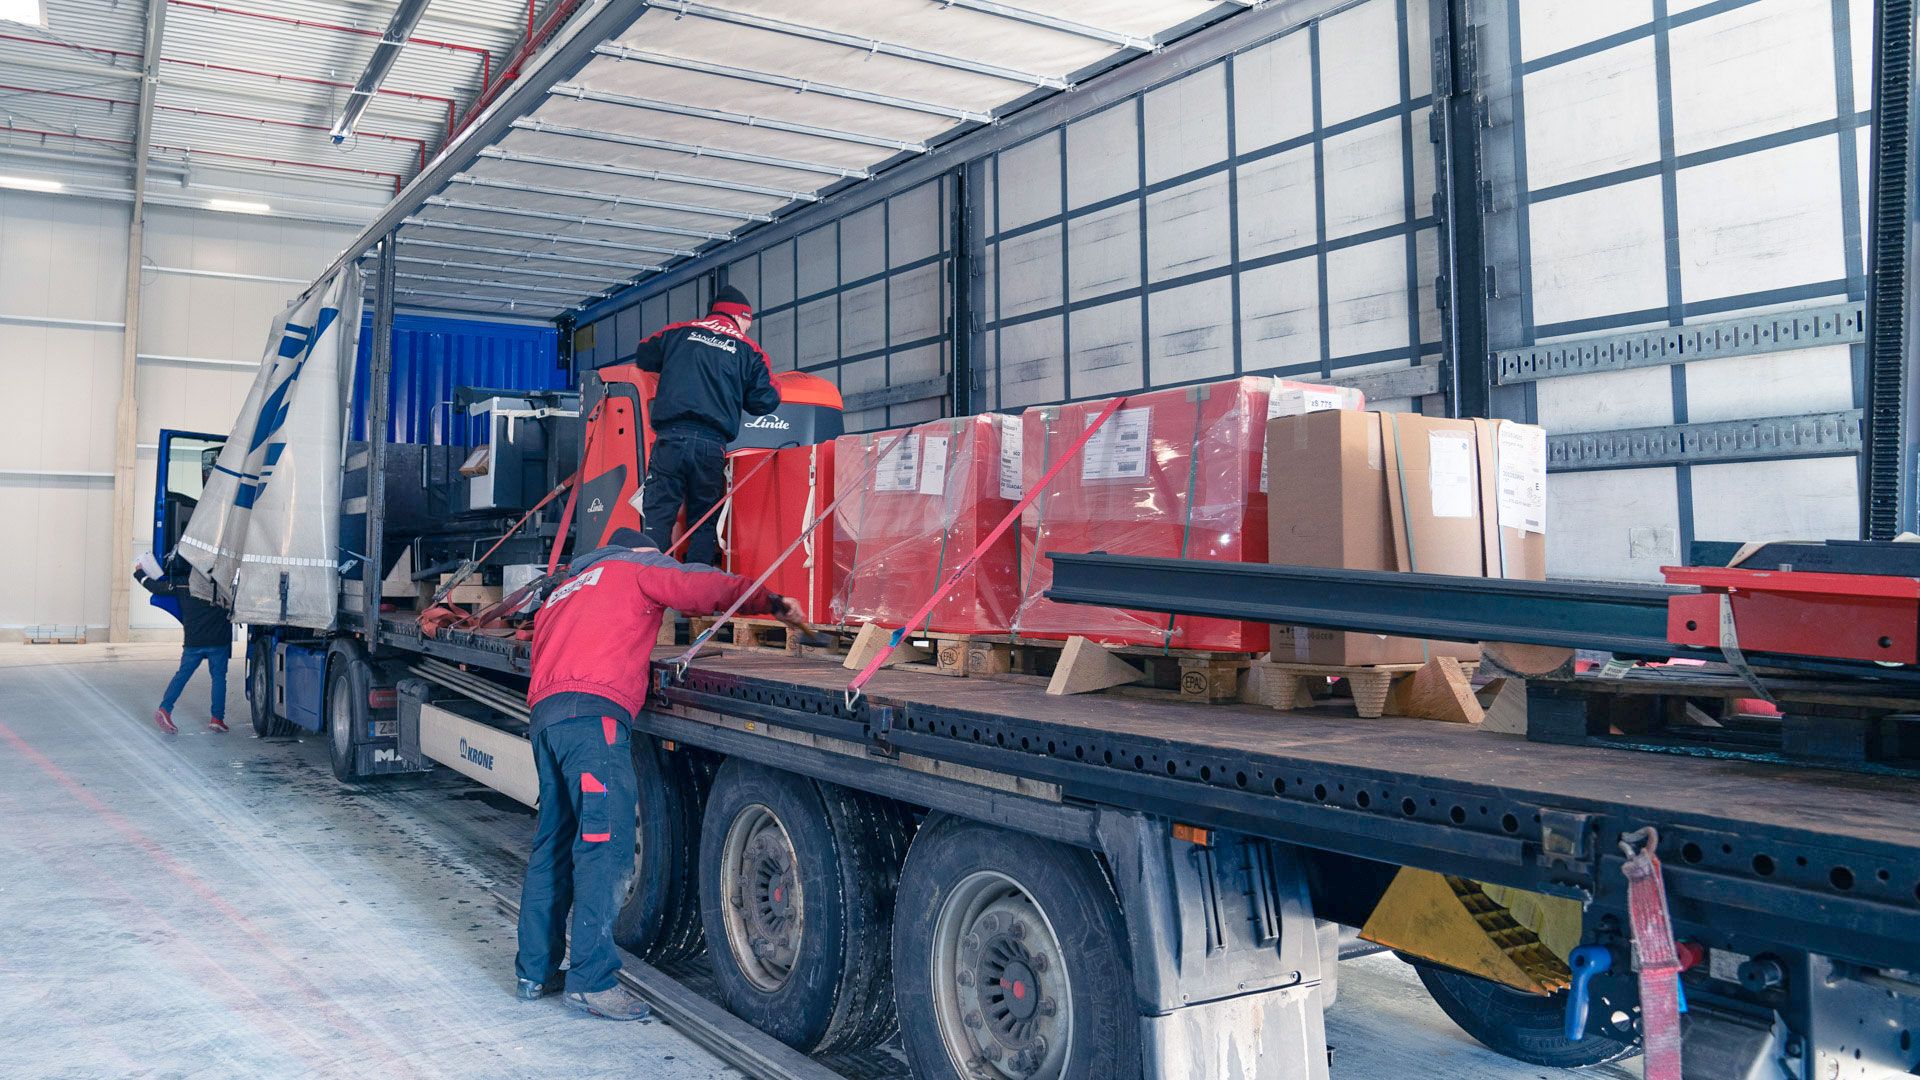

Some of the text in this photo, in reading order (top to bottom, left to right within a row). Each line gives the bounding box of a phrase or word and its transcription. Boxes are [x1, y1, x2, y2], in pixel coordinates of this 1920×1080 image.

[691, 319, 744, 338] Linde
[744, 413, 790, 430] Linde
[587, 497, 604, 513] Linde
[1185, 675, 1204, 690] EPAL
[467, 746, 494, 770] KRONE
